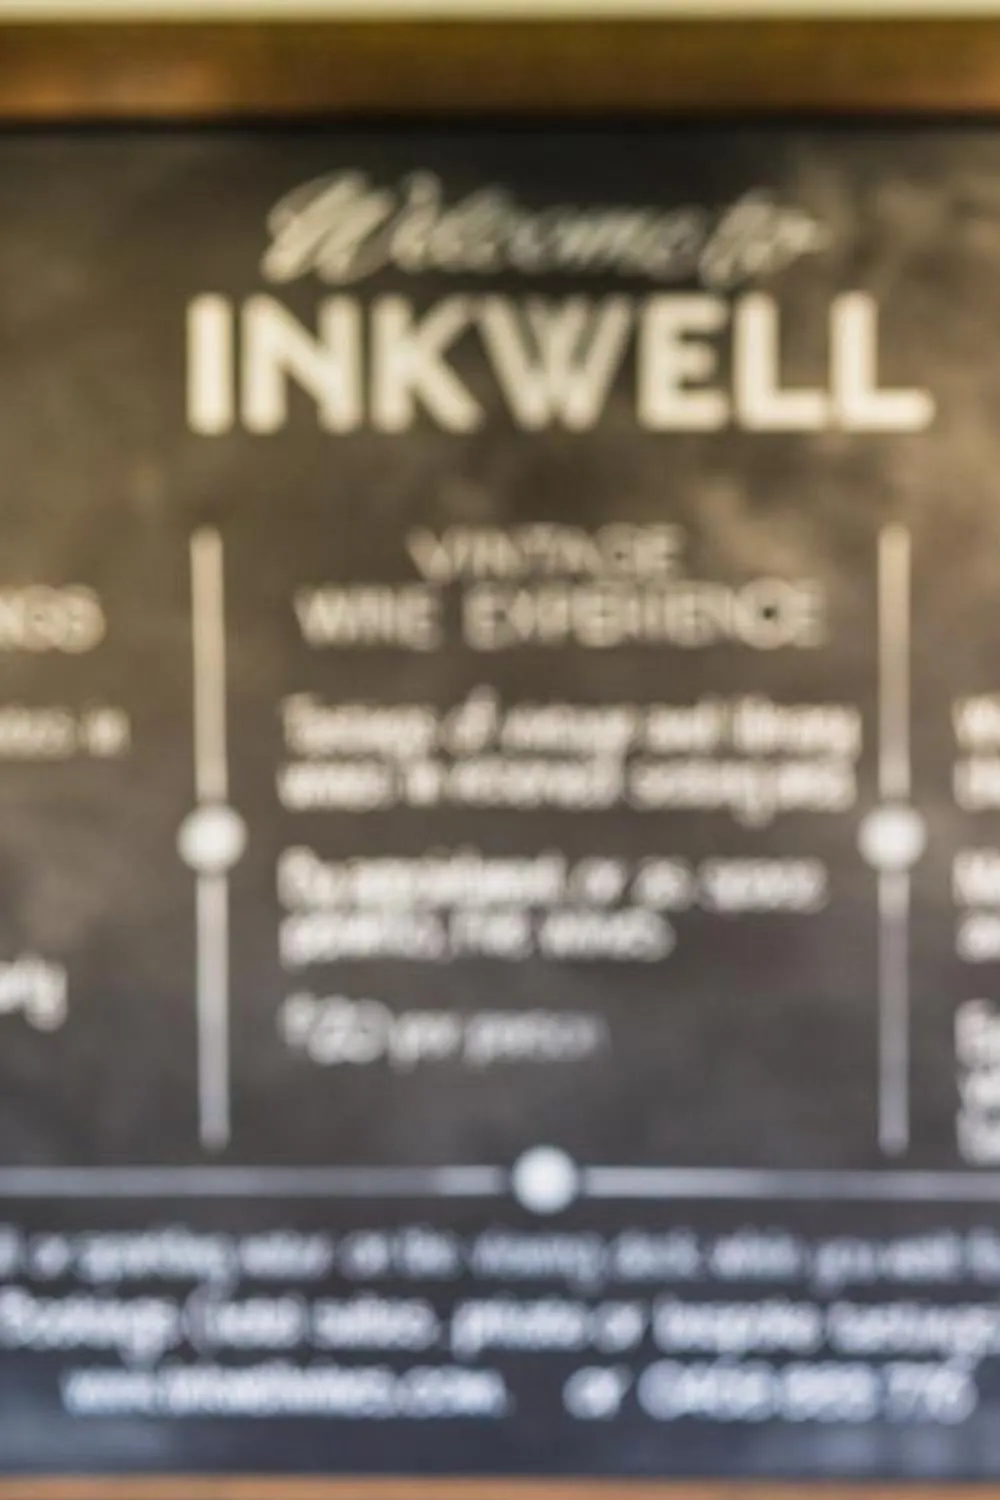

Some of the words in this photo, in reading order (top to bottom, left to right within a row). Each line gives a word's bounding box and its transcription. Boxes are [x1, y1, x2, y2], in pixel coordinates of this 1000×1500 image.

[187, 292, 936, 434] INKWELL
[295, 582, 443, 651] WINE
[462, 578, 824, 651] EXPERIENCE
